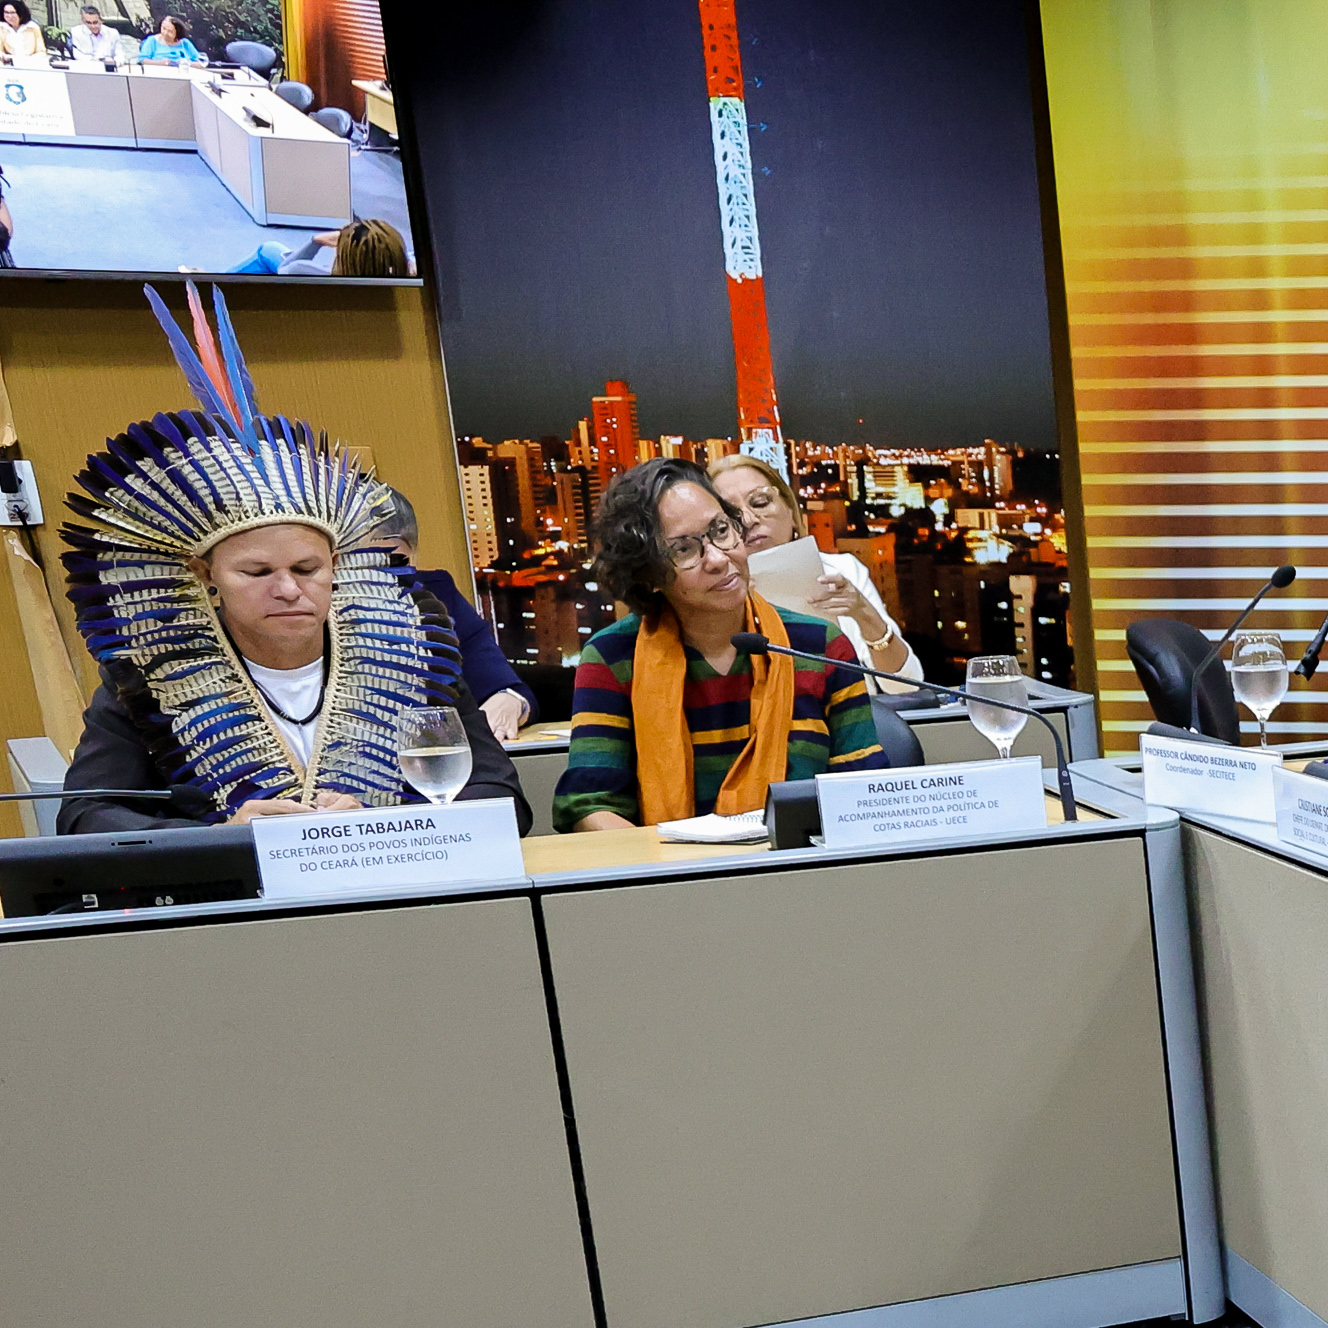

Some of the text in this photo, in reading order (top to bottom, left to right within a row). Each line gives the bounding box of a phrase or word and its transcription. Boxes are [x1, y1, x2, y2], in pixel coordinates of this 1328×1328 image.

[1145, 747, 1257, 771] PROFESSOR CÂNDIDO BEZERRA NETO
[1165, 762, 1204, 776] Coordenador
[868, 775, 964, 794] RAQUEL CARINE
[857, 789, 978, 808] PRESIDENTE DO NÚCLEO DE
[838, 800, 999, 823] ACOMPANHAMENTO DA POLÍTICA DE
[301, 817, 436, 841] JORGE TABAJARA
[873, 822, 902, 833] COTAS
[904, 818, 938, 830] RACIAIS
[946, 815, 968, 826] UECE
[269, 832, 472, 860] SECRETÁRIO DOS POVOS INDÍGENAS
[299, 849, 448, 872] DO CEARÁ (EM EXERCÍCIO)
